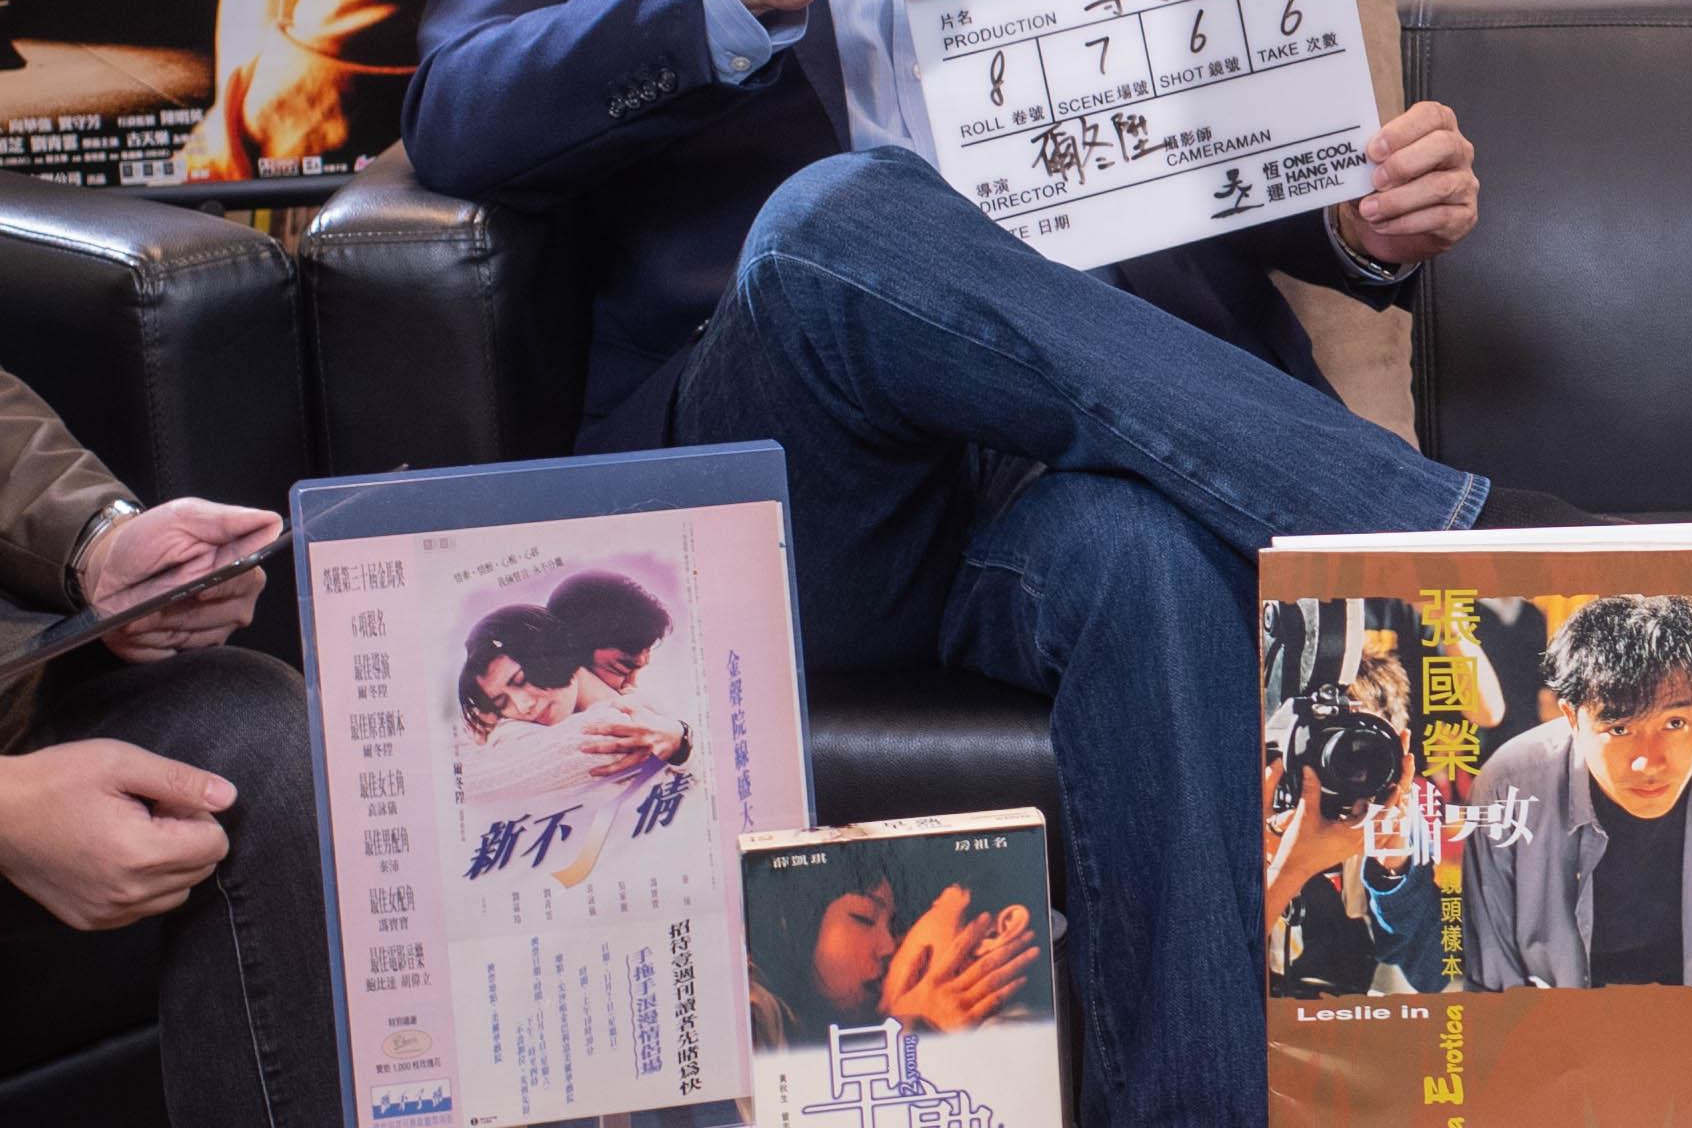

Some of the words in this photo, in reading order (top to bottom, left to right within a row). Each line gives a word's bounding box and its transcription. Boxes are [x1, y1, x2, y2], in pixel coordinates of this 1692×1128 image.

[939, 9, 973, 31] 片名
[942, 11, 1058, 51] PRODUCTION
[1189, 8, 1207, 54] 6
[1085, 35, 1110, 75] 7
[1257, 42, 1300, 63] TAKE
[1306, 32, 1339, 53] 次數
[990, 50, 1006, 107] 8
[1159, 65, 1205, 89] SHOT
[1208, 56, 1242, 78] 鏡號
[1057, 89, 1117, 116] SCENE
[1116, 79, 1150, 101] 場號
[960, 117, 1005, 139] ROLL
[1011, 105, 1046, 126] 卷號
[1163, 126, 1213, 153] 攝影師
[1166, 129, 1273, 167] CAMERAMAN
[1283, 153, 1315, 171] ONE
[1315, 141, 1358, 162] COOL
[1285, 163, 1328, 183] HANG
[1330, 152, 1368, 174] WAN
[976, 177, 1010, 199] 導演
[979, 181, 1068, 214] DIRECTOR
[1287, 173, 1345, 198] RENTAL
[1039, 214, 1071, 236] 日期
[353, 653, 391, 682] 最佳導演
[1418, 588, 1482, 782] 張國榮
[359, 769, 405, 800] 最佳女主角
[1350, 783, 1540, 867] 色情男女
[364, 827, 410, 857] 最佳男配角
[369, 884, 415, 915] 最佳女配角
[1297, 1005, 1391, 1022] Leslie
[1401, 1005, 1430, 1019] in
[1423, 1004, 1464, 1105] Erotica
